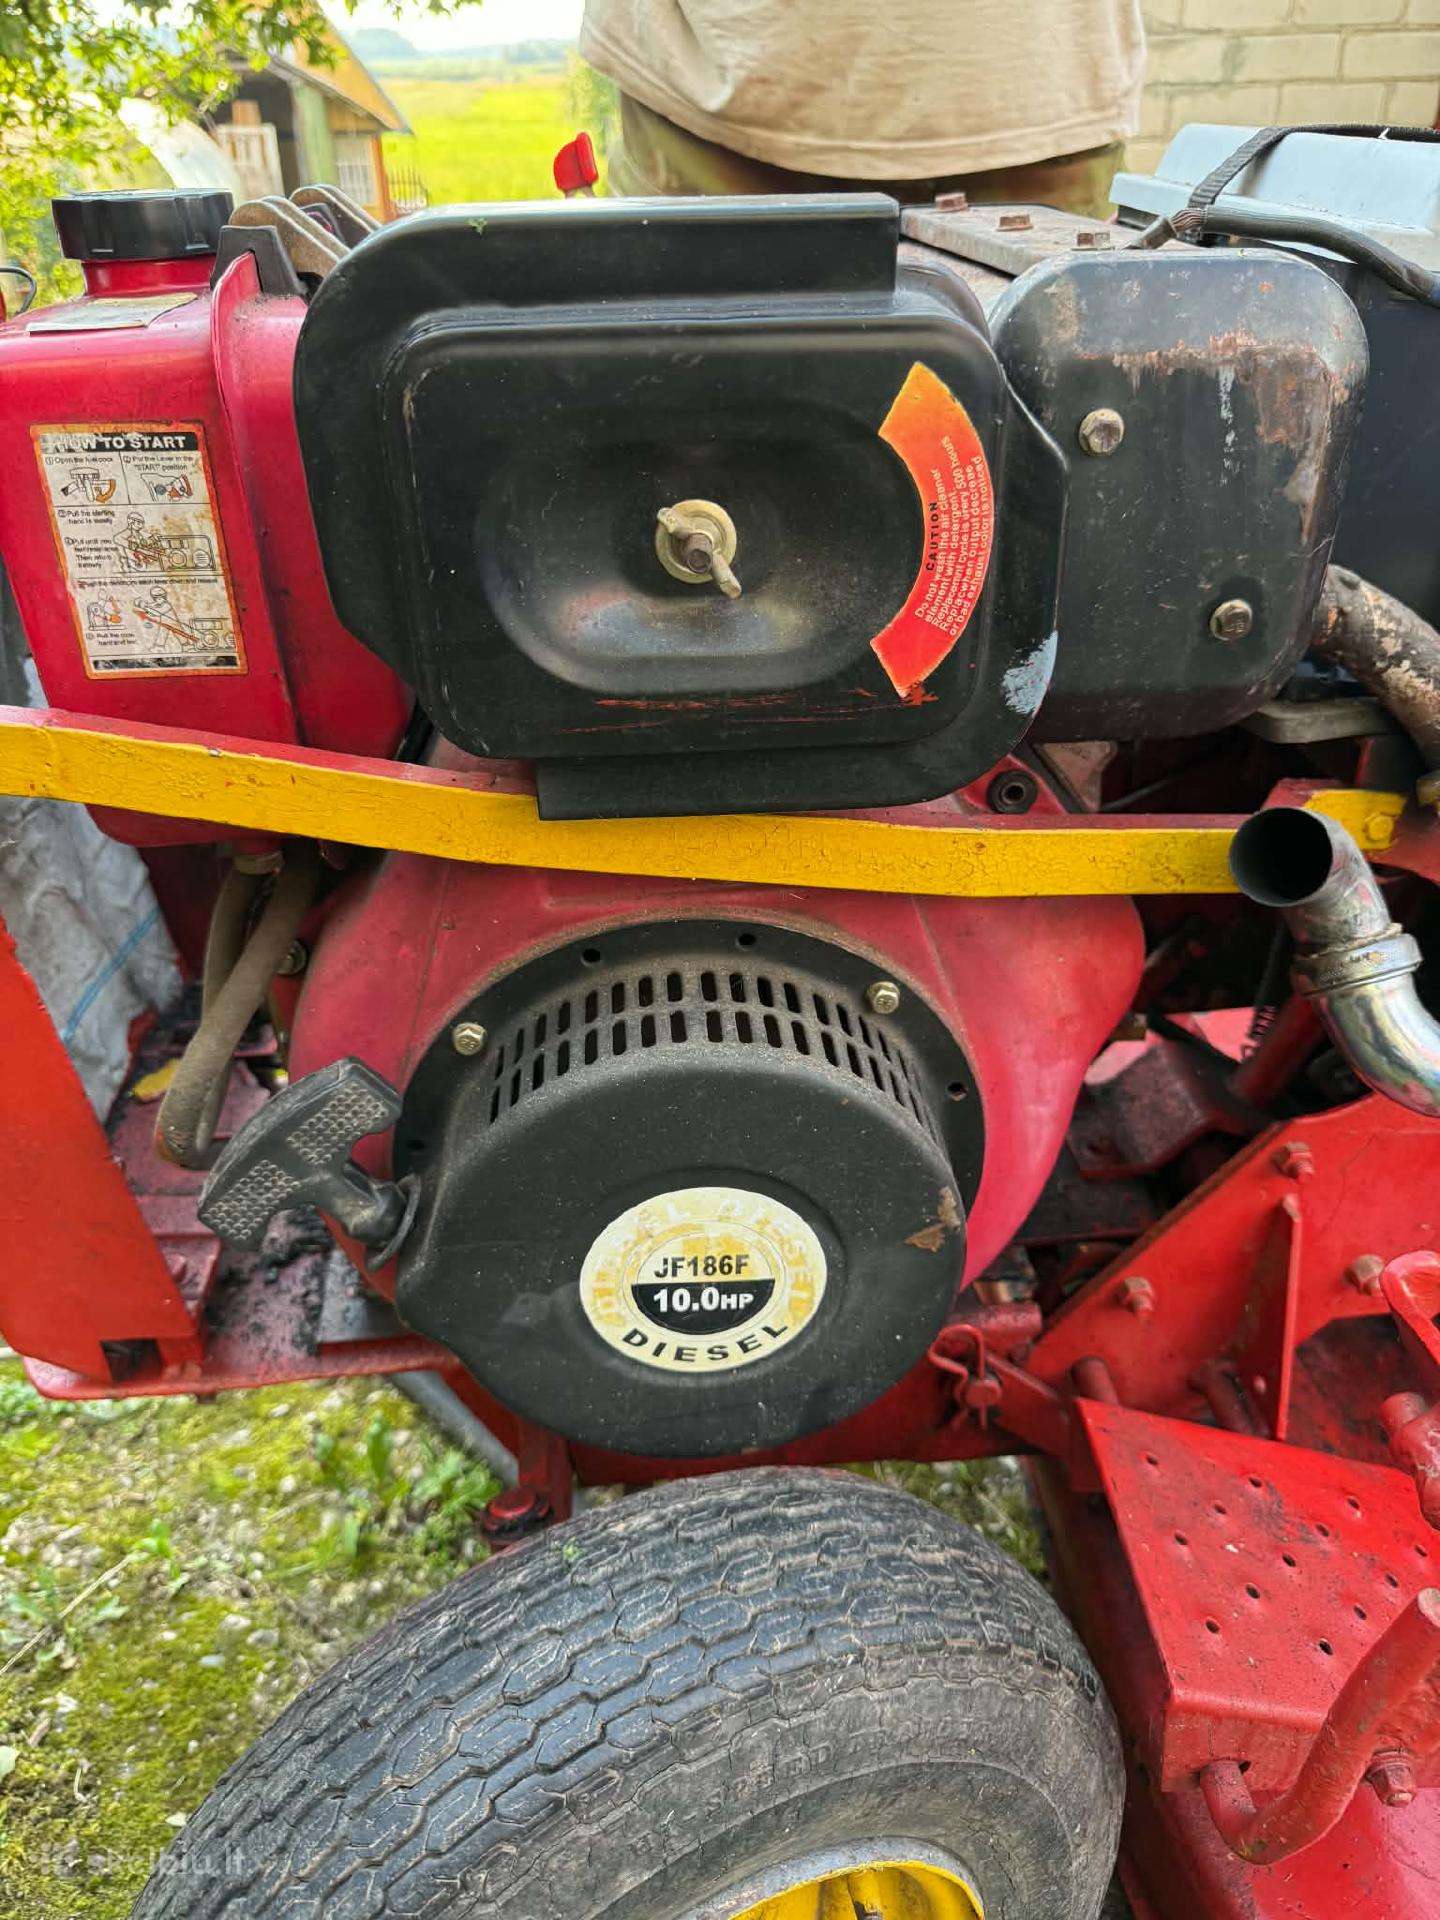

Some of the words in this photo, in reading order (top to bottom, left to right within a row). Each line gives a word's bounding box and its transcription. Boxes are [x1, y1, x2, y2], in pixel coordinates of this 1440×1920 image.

[103, 437, 126, 450] TO
[129, 435, 187, 449] START
[941, 435, 960, 468] hours
[931, 467, 949, 511] cleaner
[952, 466, 967, 490] 500
[970, 455, 988, 502] noticed
[940, 512, 949, 529] air
[926, 502, 939, 571] CAUTION
[939, 531, 950, 549] the
[968, 517, 981, 557] output
[934, 551, 947, 580] wash
[944, 552, 958, 577] with
[966, 552, 986, 599] exhaust
[925, 583, 938, 601] not
[914, 602, 929, 617] Do
[955, 600, 971, 623] bad
[949, 623, 960, 635] or
[653, 1254, 750, 1278] JF186F
[653, 1286, 754, 1313] 10.0HP
[621, 1324, 789, 1363] DIESEL
